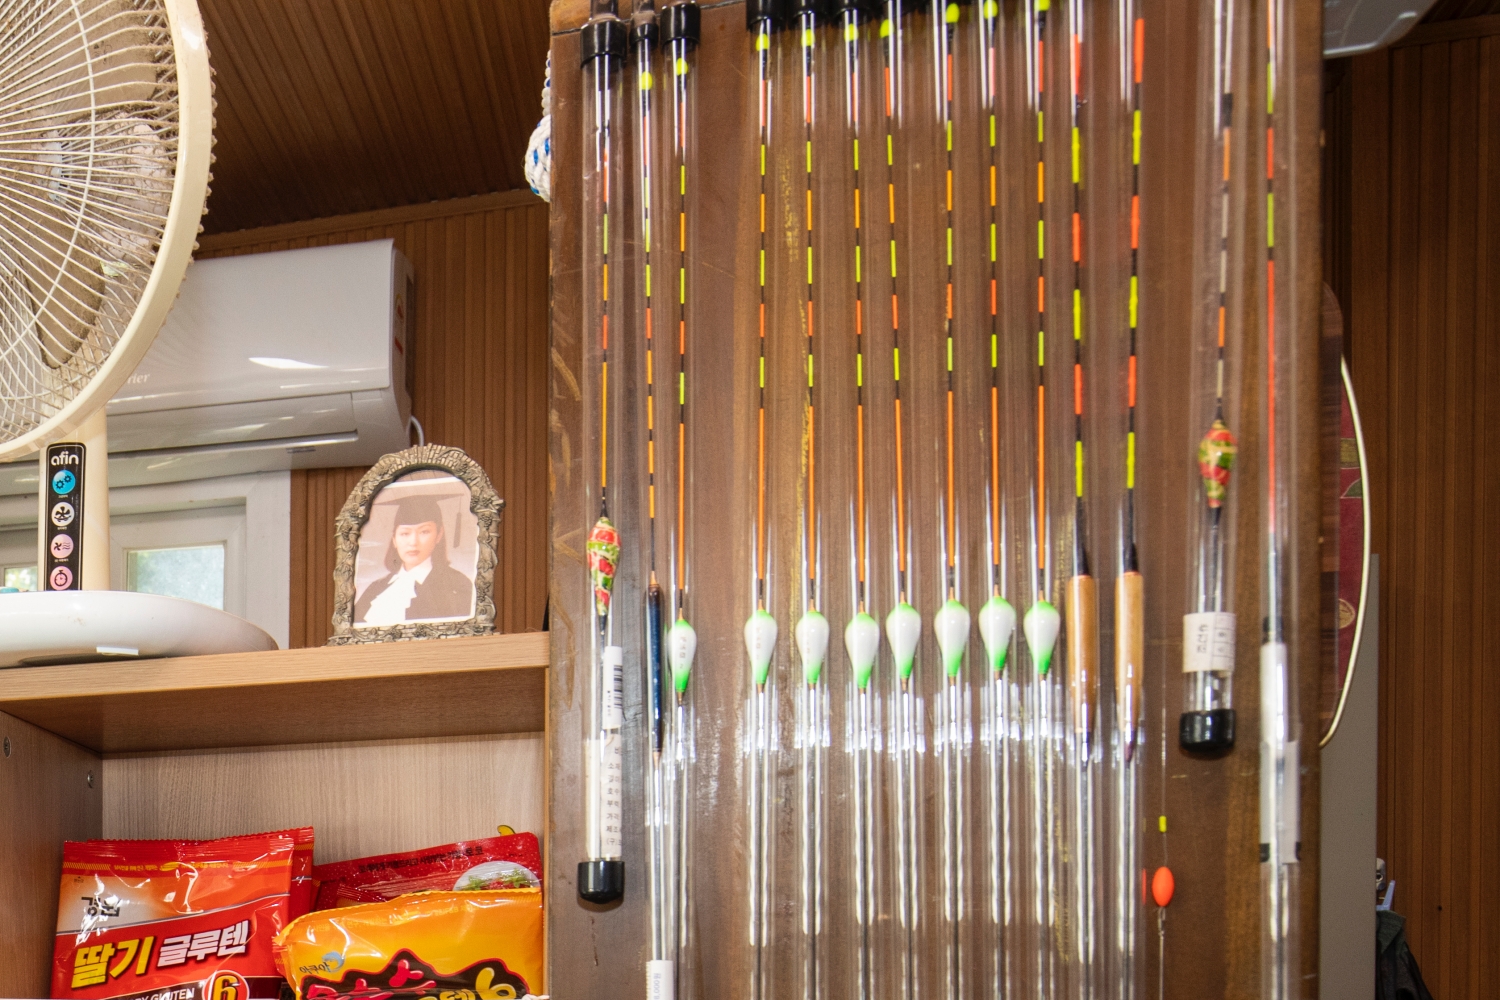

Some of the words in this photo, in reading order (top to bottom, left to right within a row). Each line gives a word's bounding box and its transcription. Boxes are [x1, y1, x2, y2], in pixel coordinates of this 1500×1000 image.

[51, 451, 79, 466] afin
[71, 936, 155, 989] 딸기
[156, 919, 250, 968] 글루텐
